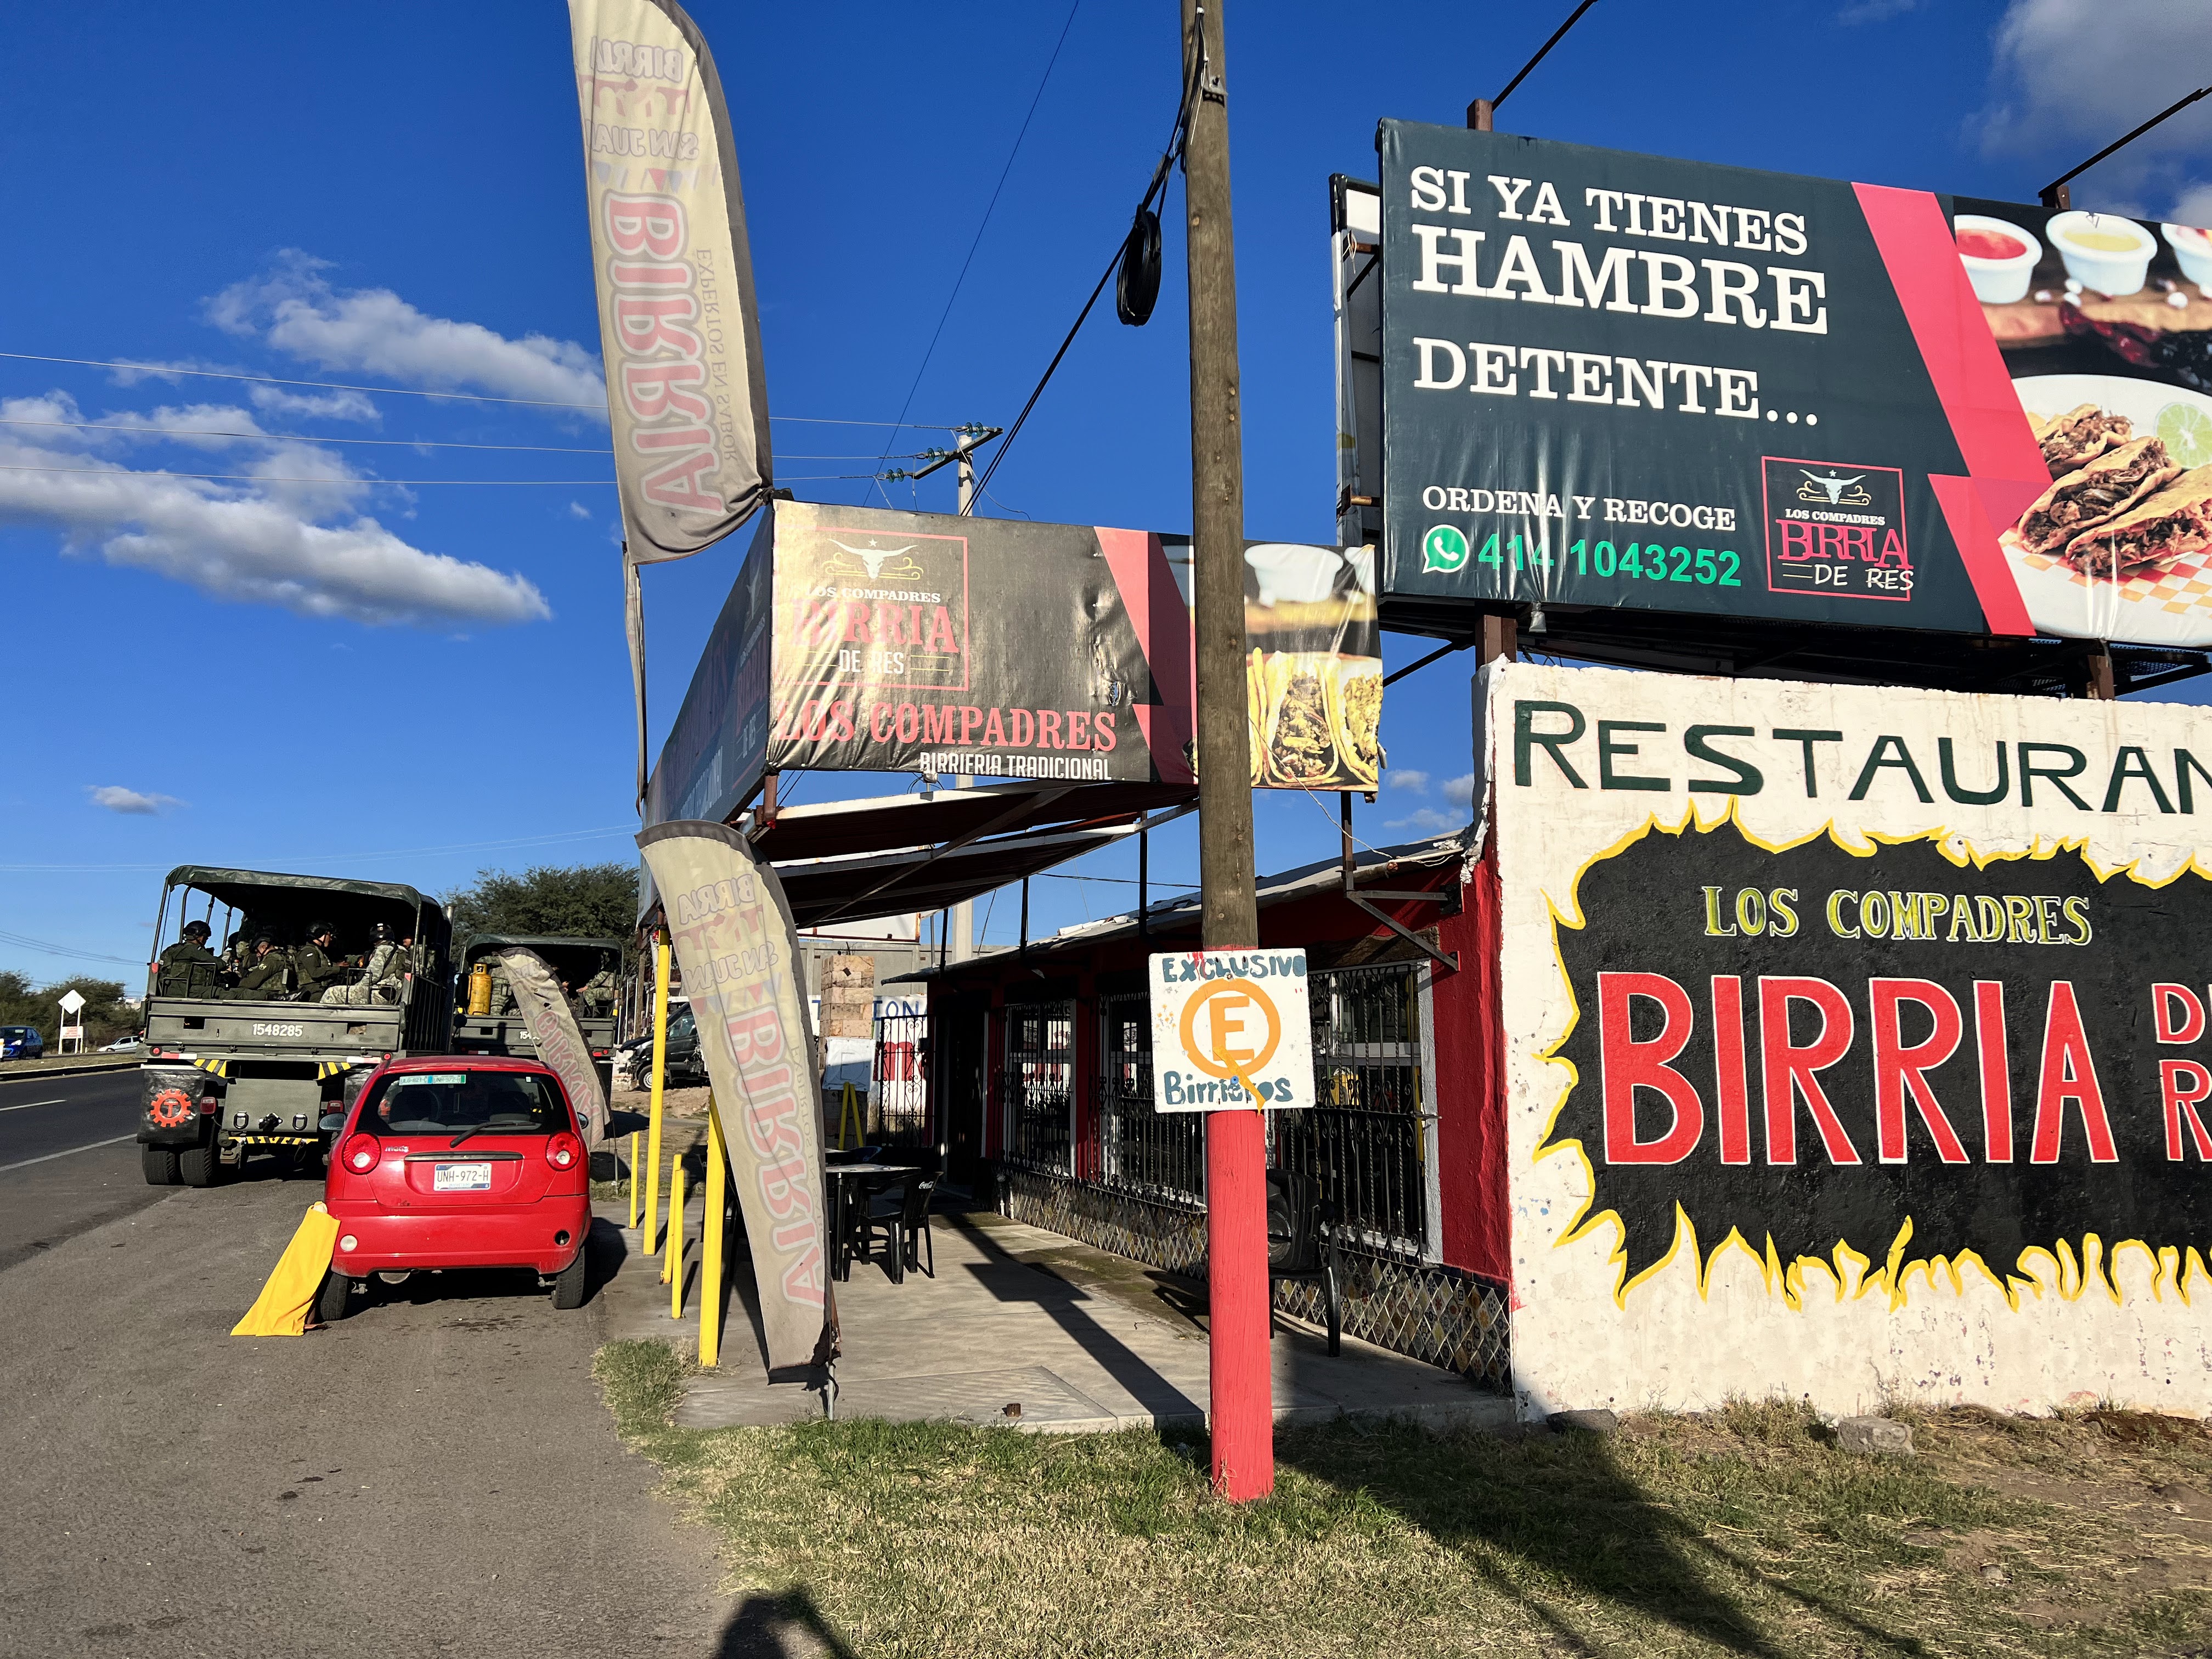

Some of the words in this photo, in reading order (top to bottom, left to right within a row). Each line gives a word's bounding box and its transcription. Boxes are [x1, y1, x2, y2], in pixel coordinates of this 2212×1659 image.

[1410, 165, 1471, 215] SI
[1488, 174, 1571, 227] YA
[1585, 187, 1808, 256] TIENES
[1411, 223, 1828, 335] HAMBRE
[1413, 336, 1819, 427] DETENTE...
[1422, 486, 1565, 518] ORDENA
[1572, 495, 1596, 520] Y
[1604, 497, 1736, 532] RECOGE
[1785, 508, 1810, 520] LOS
[1812, 511, 1886, 526] COMPADRES
[1477, 533, 1555, 574] 414
[1570, 538, 1742, 587] 1043252
[1775, 518, 1914, 569] BIRRIA
[842, 587, 941, 603] COMPADRES
[1815, 563, 1848, 586] DE
[1866, 567, 1914, 591] RES
[839, 649, 861, 673] DE
[871, 651, 905, 675] RES
[870, 701, 1117, 752] COMPADRES
[919, 752, 1002, 776] BIRRIERIA
[1006, 754, 1112, 781] TRADICIONAL
[1702, 886, 1799, 939] LOS
[1826, 888, 2094, 947] COMPADRES
[1162, 954, 1307, 983] EXCLUSIVO
[252, 1023, 303, 1037] 1548285
[2151, 982, 2212, 1046] D
[1596, 970, 2120, 1167] BIRRIA
[437, 1170, 489, 1182] UNH-972-H
